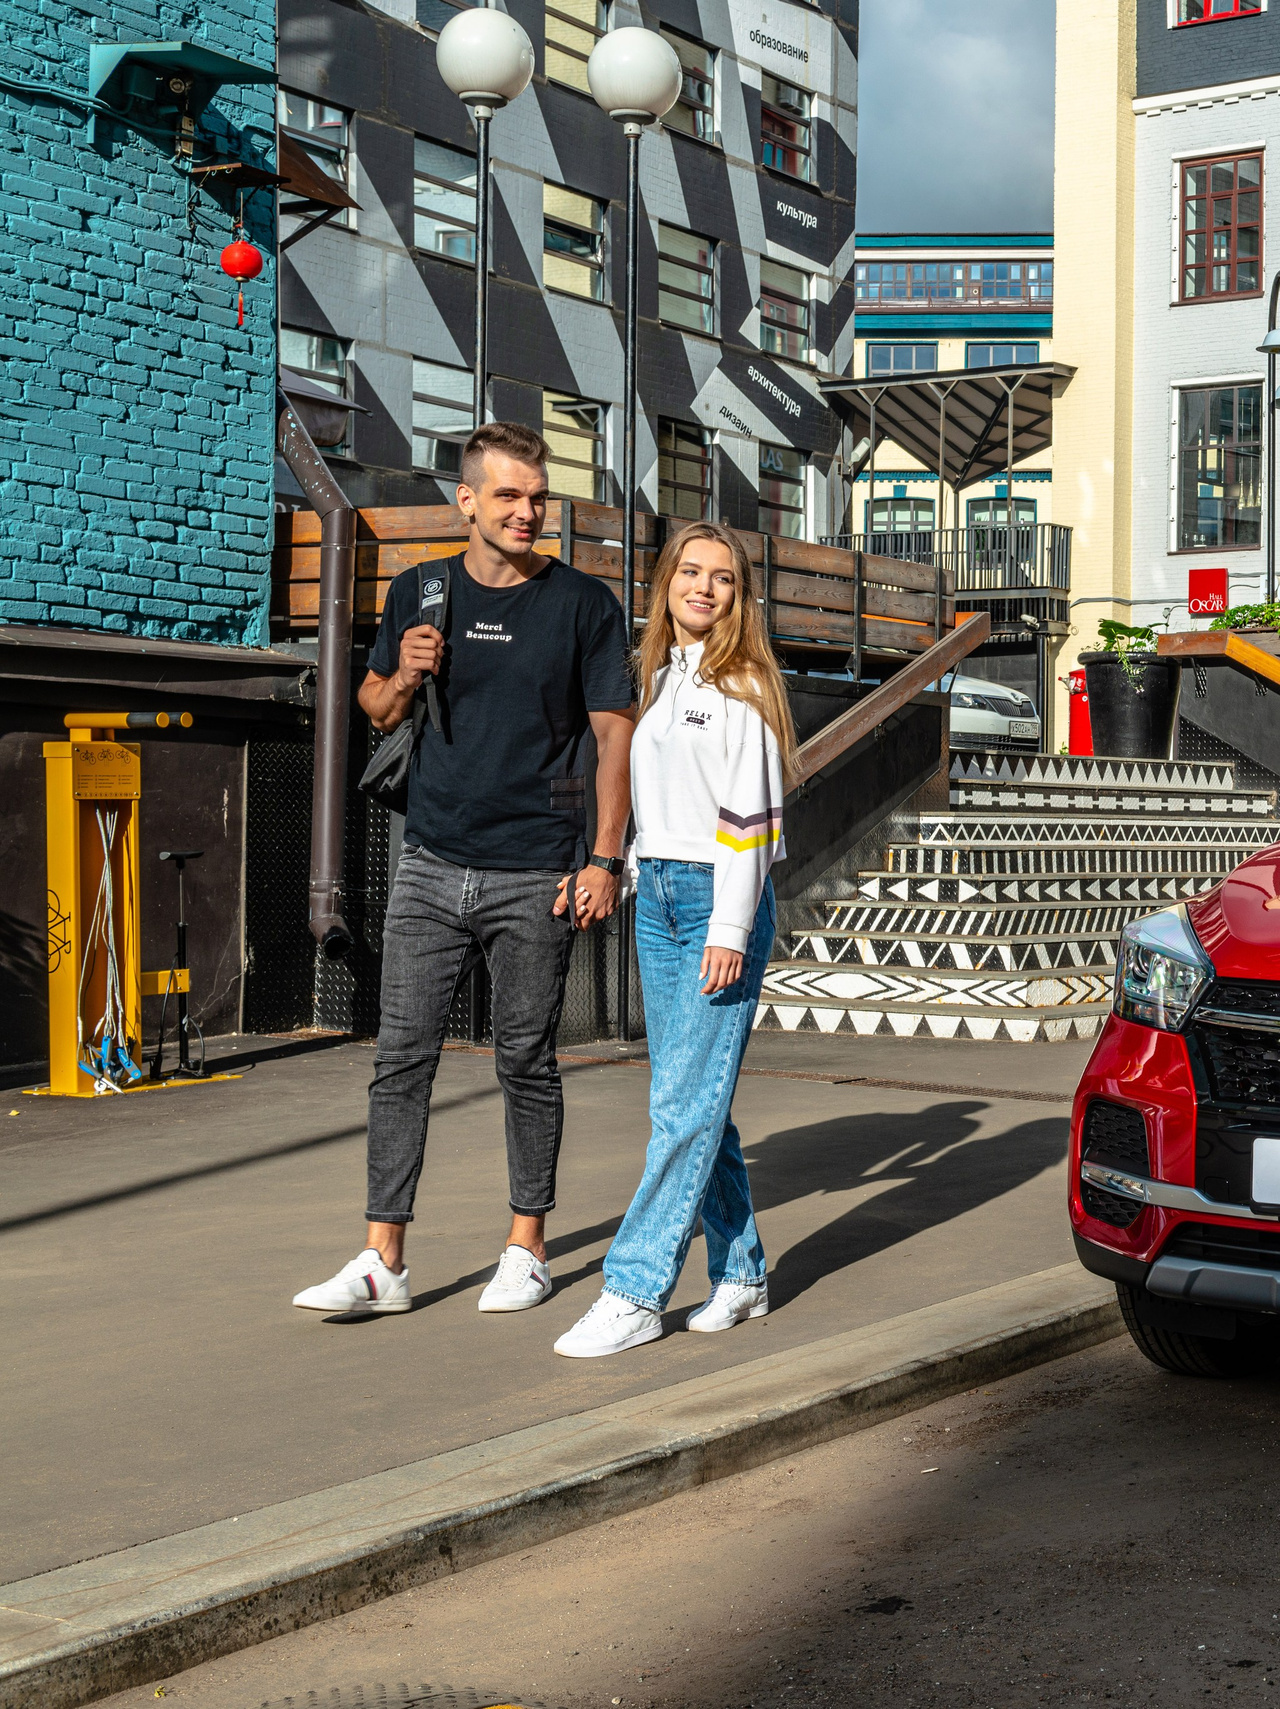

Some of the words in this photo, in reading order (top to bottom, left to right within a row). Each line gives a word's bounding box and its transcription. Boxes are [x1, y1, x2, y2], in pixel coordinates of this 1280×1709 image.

[749, 29, 809, 63] образование
[777, 200, 818, 229] культура
[747, 365, 802, 418] архитектура
[1190, 598, 1224, 613] OSCAR
[475, 622, 503, 631] Merci
[466, 631, 513, 642] Beaucoup
[684, 709, 712, 721] RELAX
